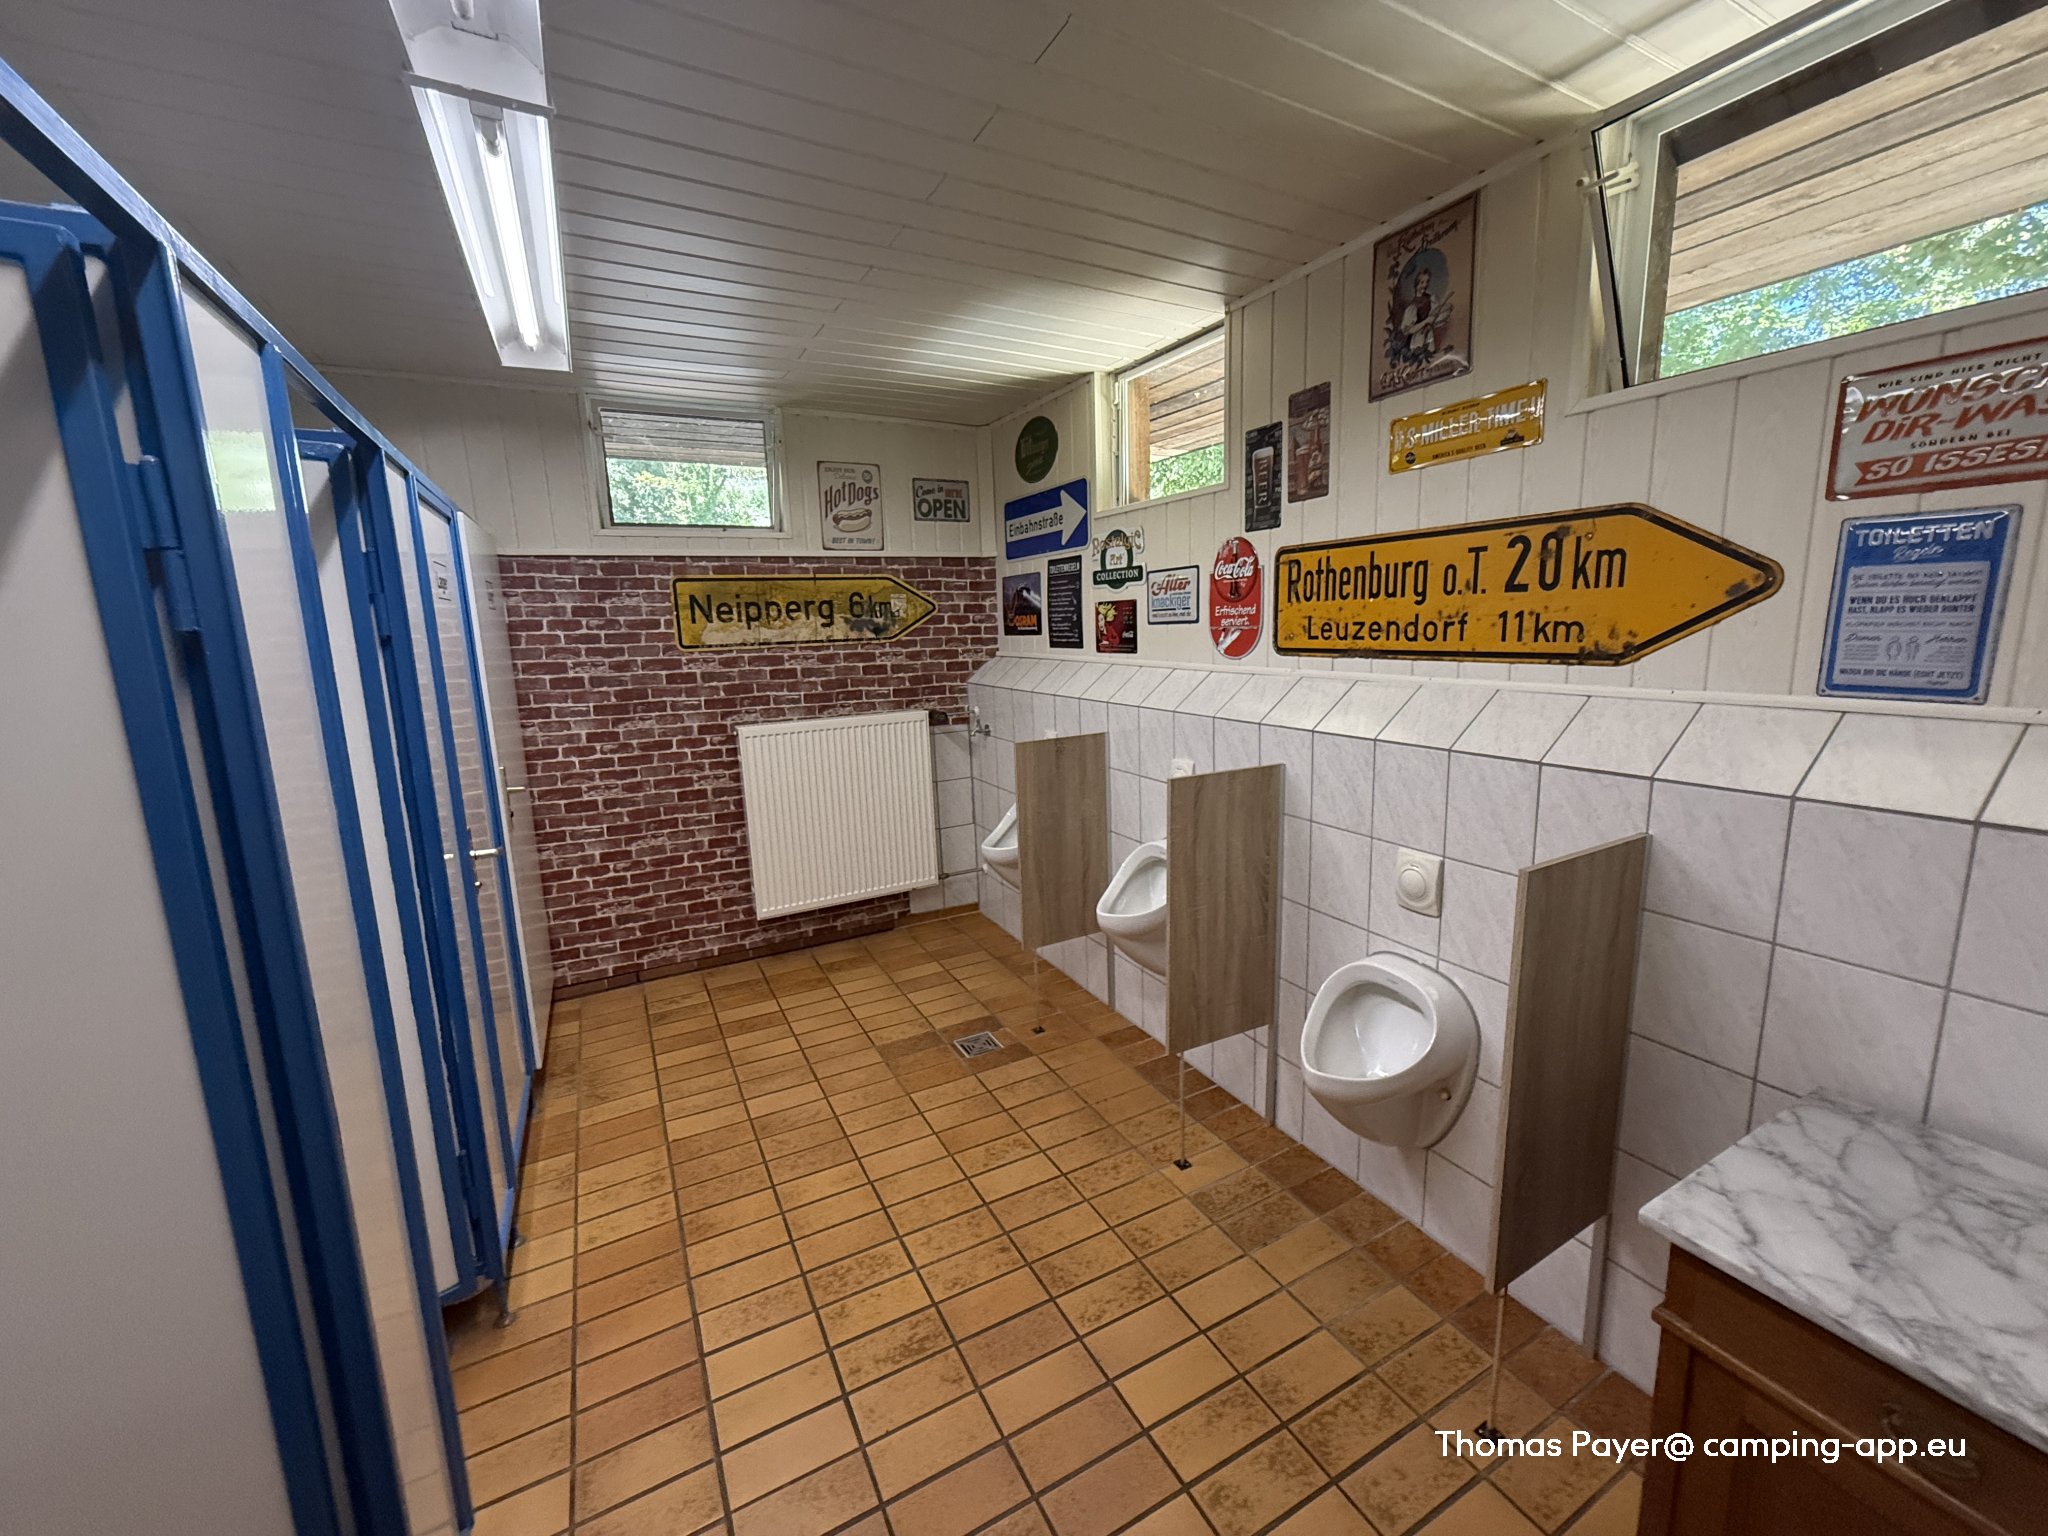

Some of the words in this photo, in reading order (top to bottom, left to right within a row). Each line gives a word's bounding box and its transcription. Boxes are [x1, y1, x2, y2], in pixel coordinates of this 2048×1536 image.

[1877, 381, 1901, 389] WIR
[1910, 371, 1944, 383] SIND
[1951, 363, 1985, 375] HIER
[1993, 352, 2042, 367] NICHT
[1421, 411, 1480, 446] MILLER
[1911, 434, 1978, 450] SONDERN
[1987, 429, 2011, 438] BEI
[1866, 456, 1913, 480] SO
[824, 481, 847, 520] Hot
[848, 482, 879, 506] Dogs
[915, 485, 935, 498] Come
[937, 484, 944, 493] in
[917, 498, 966, 518] OPEN
[1008, 512, 1064, 538] Einbahnstraße
[1855, 520, 1995, 547] TOILETTEN
[1096, 569, 1139, 581] COLLECTION
[1287, 551, 1428, 606] Rothenburg
[1443, 546, 1488, 596] o.T.
[1504, 531, 1563, 592] 20
[1572, 536, 1627, 589] km
[688, 593, 835, 629] Neipperg
[849, 591, 865, 618] 6
[1015, 614, 1037, 627] OSRAM
[1215, 604, 1256, 616] Erfrischend
[1307, 613, 1469, 642] Leuzendorf
[1499, 610, 1525, 642] 11
[1533, 612, 1585, 643] km
